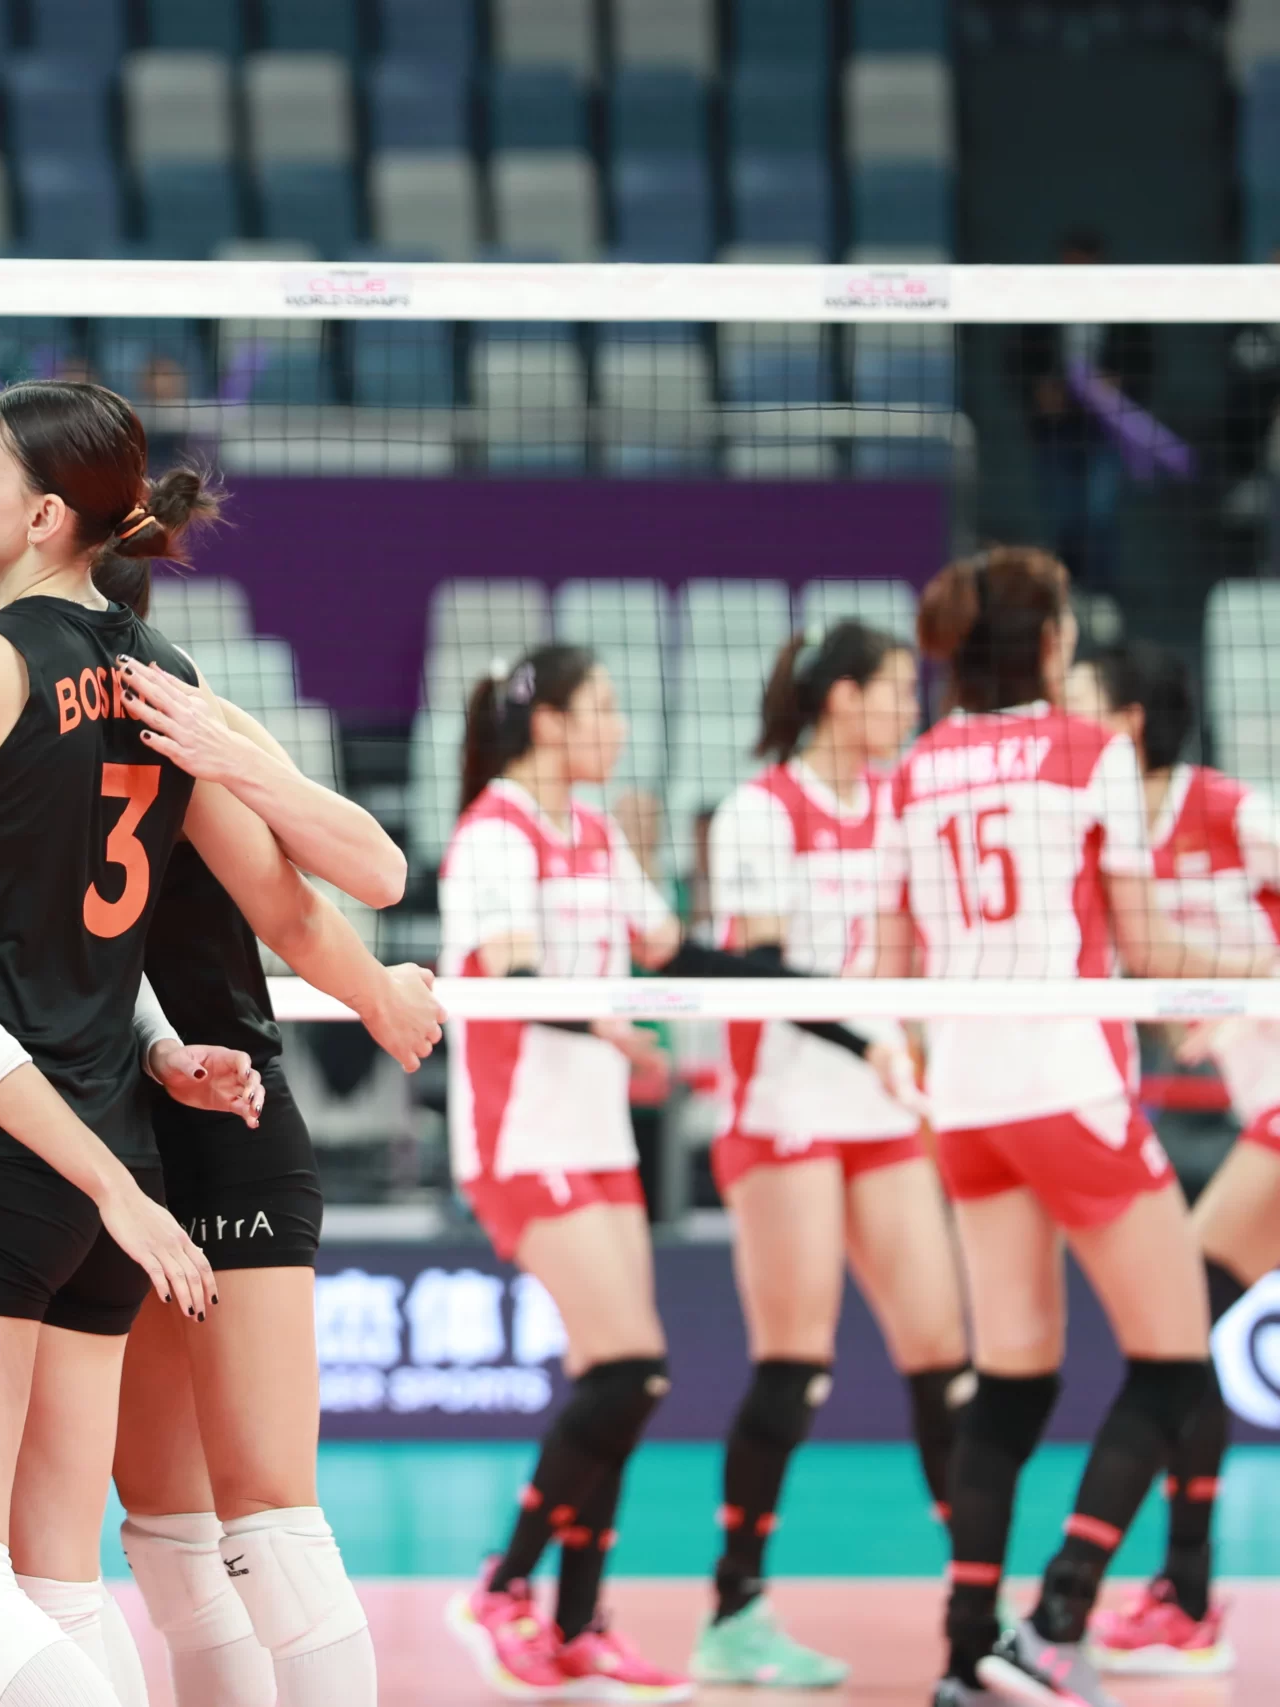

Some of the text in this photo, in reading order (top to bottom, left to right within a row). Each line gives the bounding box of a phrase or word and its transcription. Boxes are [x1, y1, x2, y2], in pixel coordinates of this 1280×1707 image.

[83, 762, 161, 938] 3
[938, 806, 1018, 930] 15
[387, 1365, 552, 1413] SPORTS
